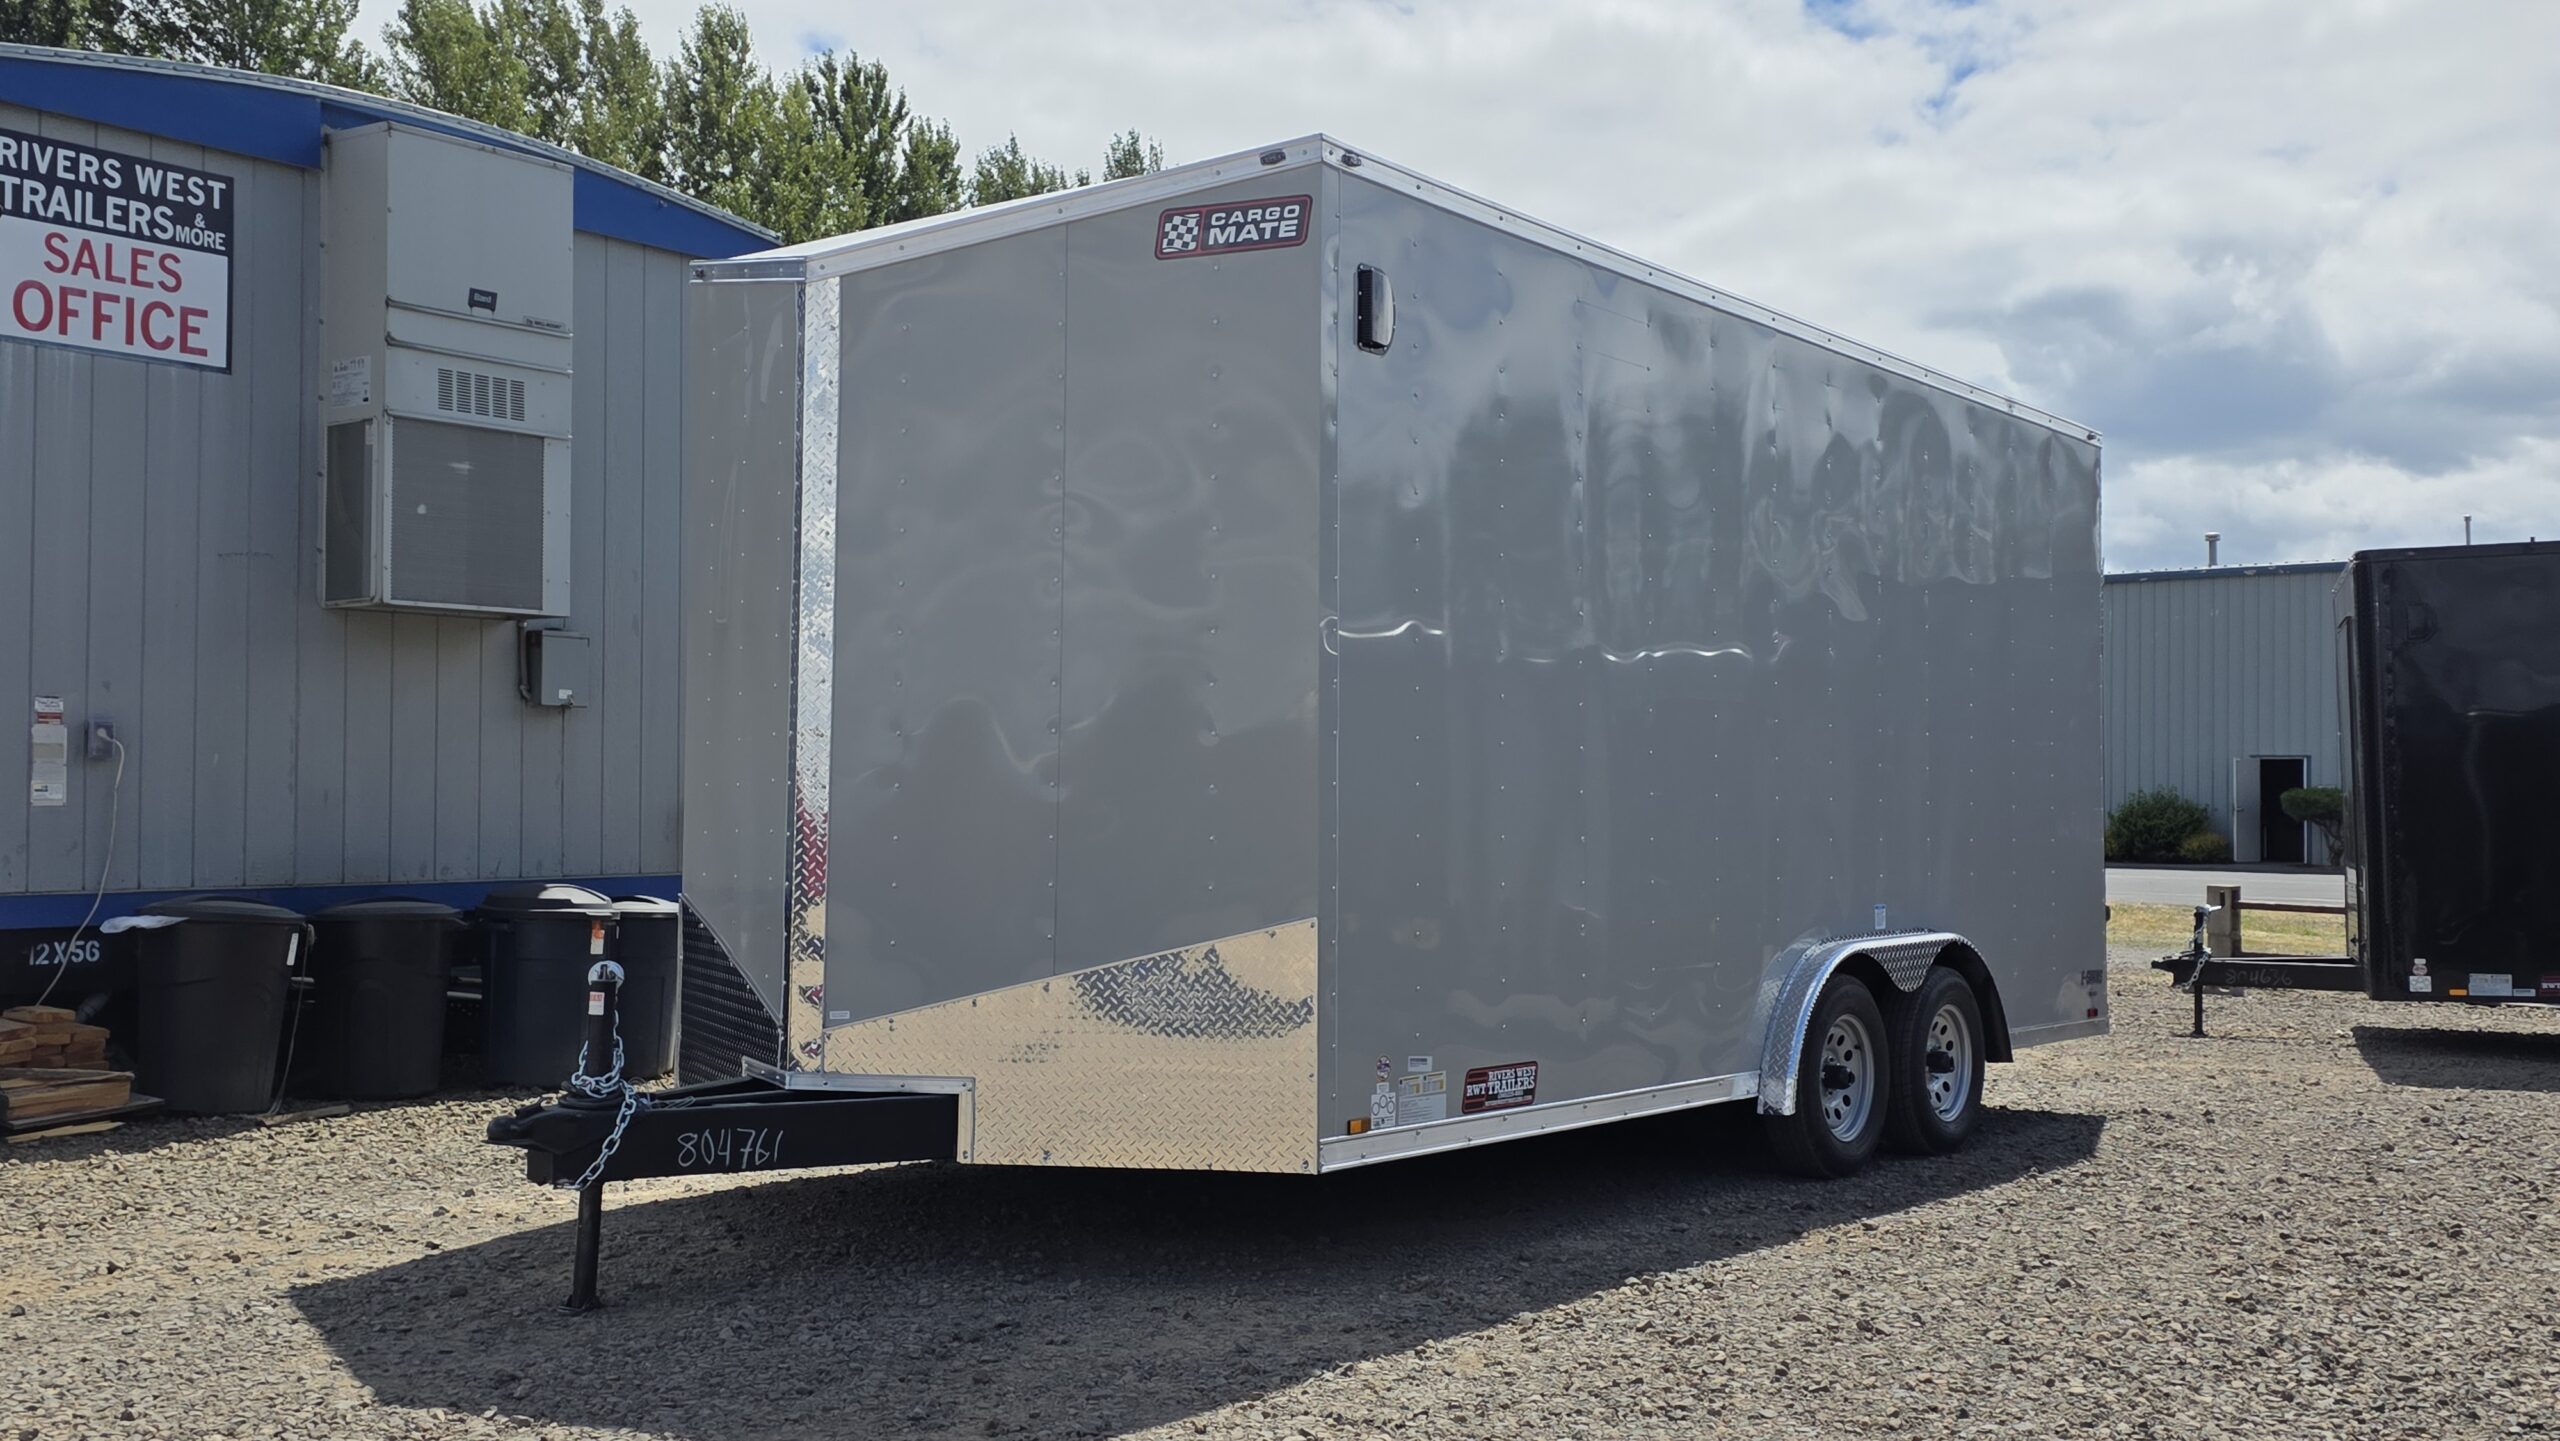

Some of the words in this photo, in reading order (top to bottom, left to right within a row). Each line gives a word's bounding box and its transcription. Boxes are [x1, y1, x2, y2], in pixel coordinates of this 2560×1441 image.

[0, 136, 122, 190] RIVERS
[135, 164, 226, 210] WEST
[0, 175, 174, 240] TRAILERS
[194, 212, 206, 229] &
[1211, 204, 1300, 226] CARGO
[175, 224, 226, 251] MORE
[1208, 219, 1298, 245] MATE
[43, 231, 183, 294] SALES
[12, 279, 209, 358] OFFICE
[1487, 1076, 1536, 1095] TRAILERS
[1488, 1069, 1516, 1081] RIVERS
[1516, 1065, 1537, 1077] WEST
[1466, 1083, 1487, 1097] RWT
[677, 1127, 784, 1170] 804761
